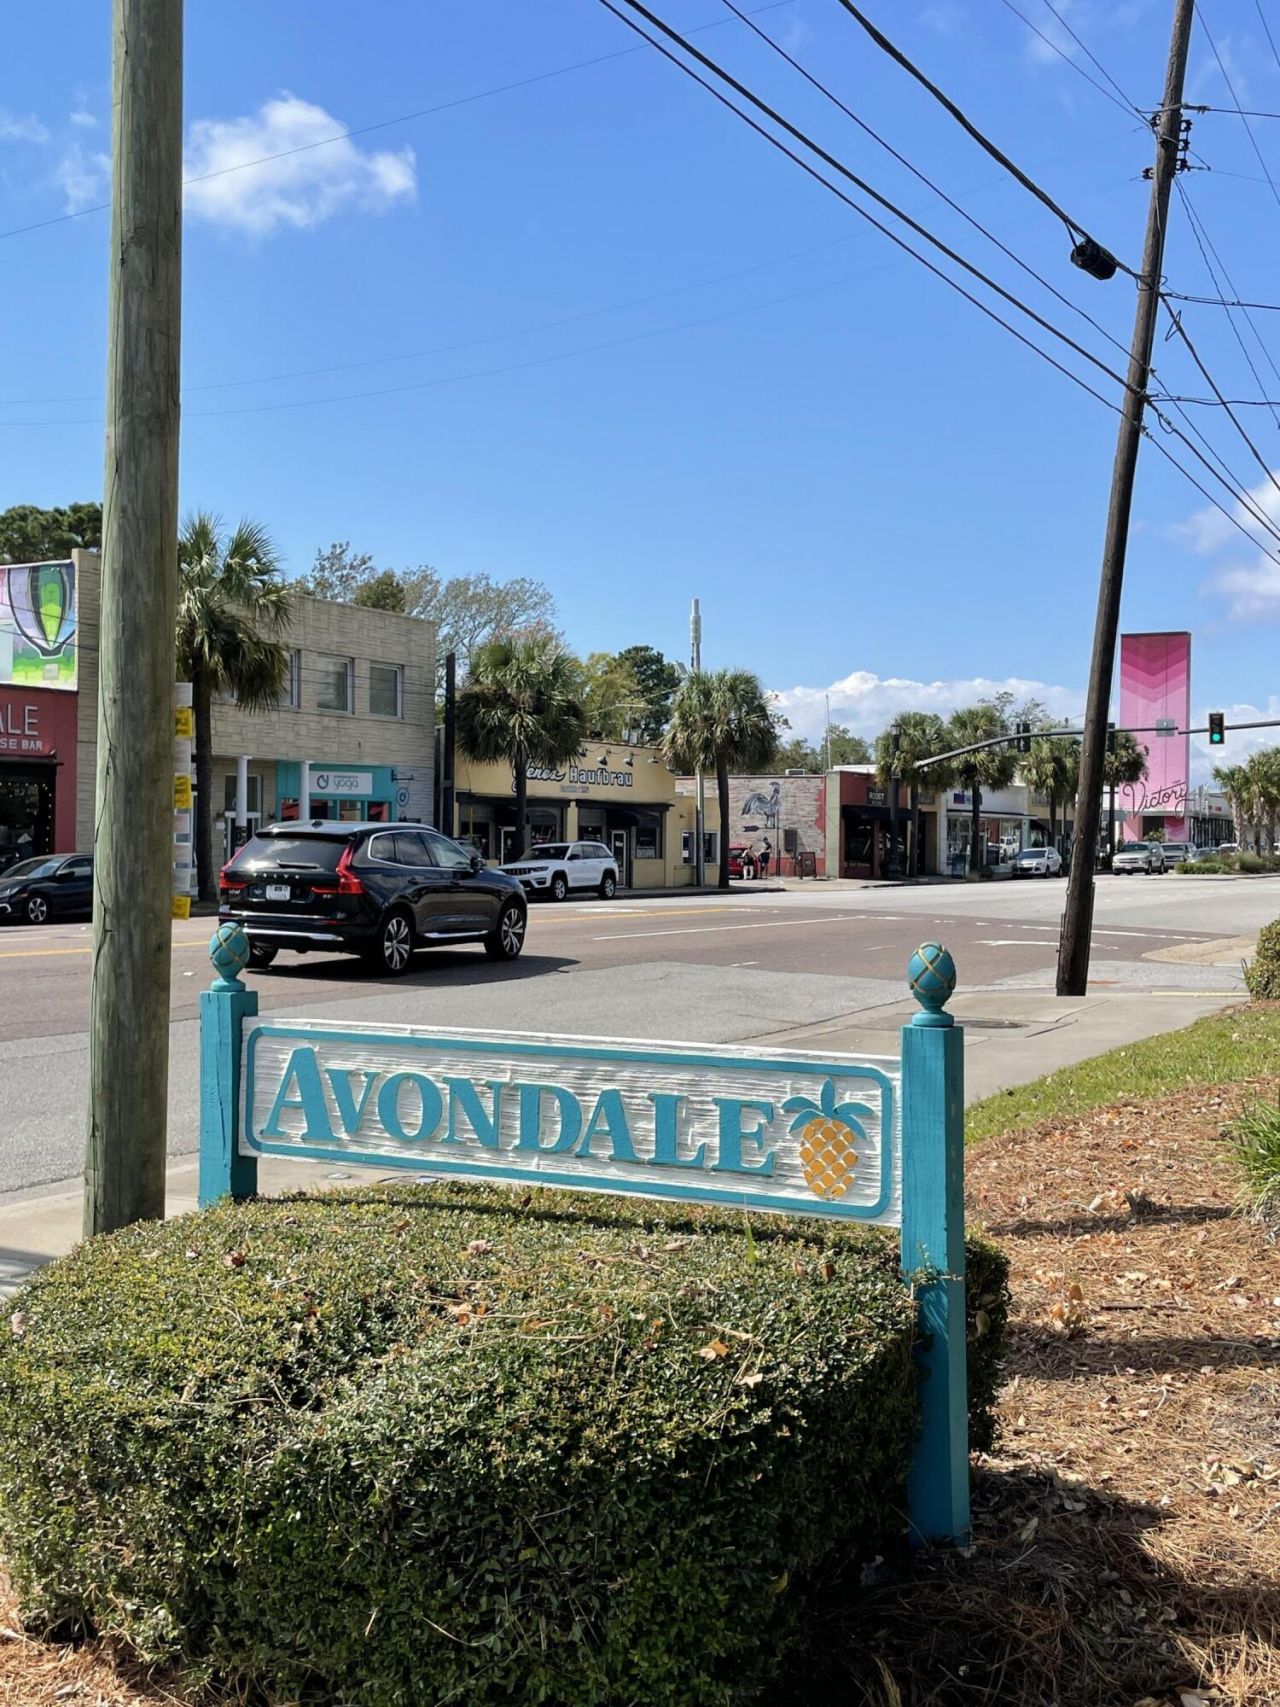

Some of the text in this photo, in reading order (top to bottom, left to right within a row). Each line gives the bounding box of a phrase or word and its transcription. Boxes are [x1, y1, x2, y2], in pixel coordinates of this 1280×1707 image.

[22, 740, 43, 751] BAR
[333, 779, 359, 791] yoga
[569, 766, 633, 786] Haufbrau
[1123, 781, 1195, 819] Victory
[262, 1047, 775, 1172] AVONDALE
